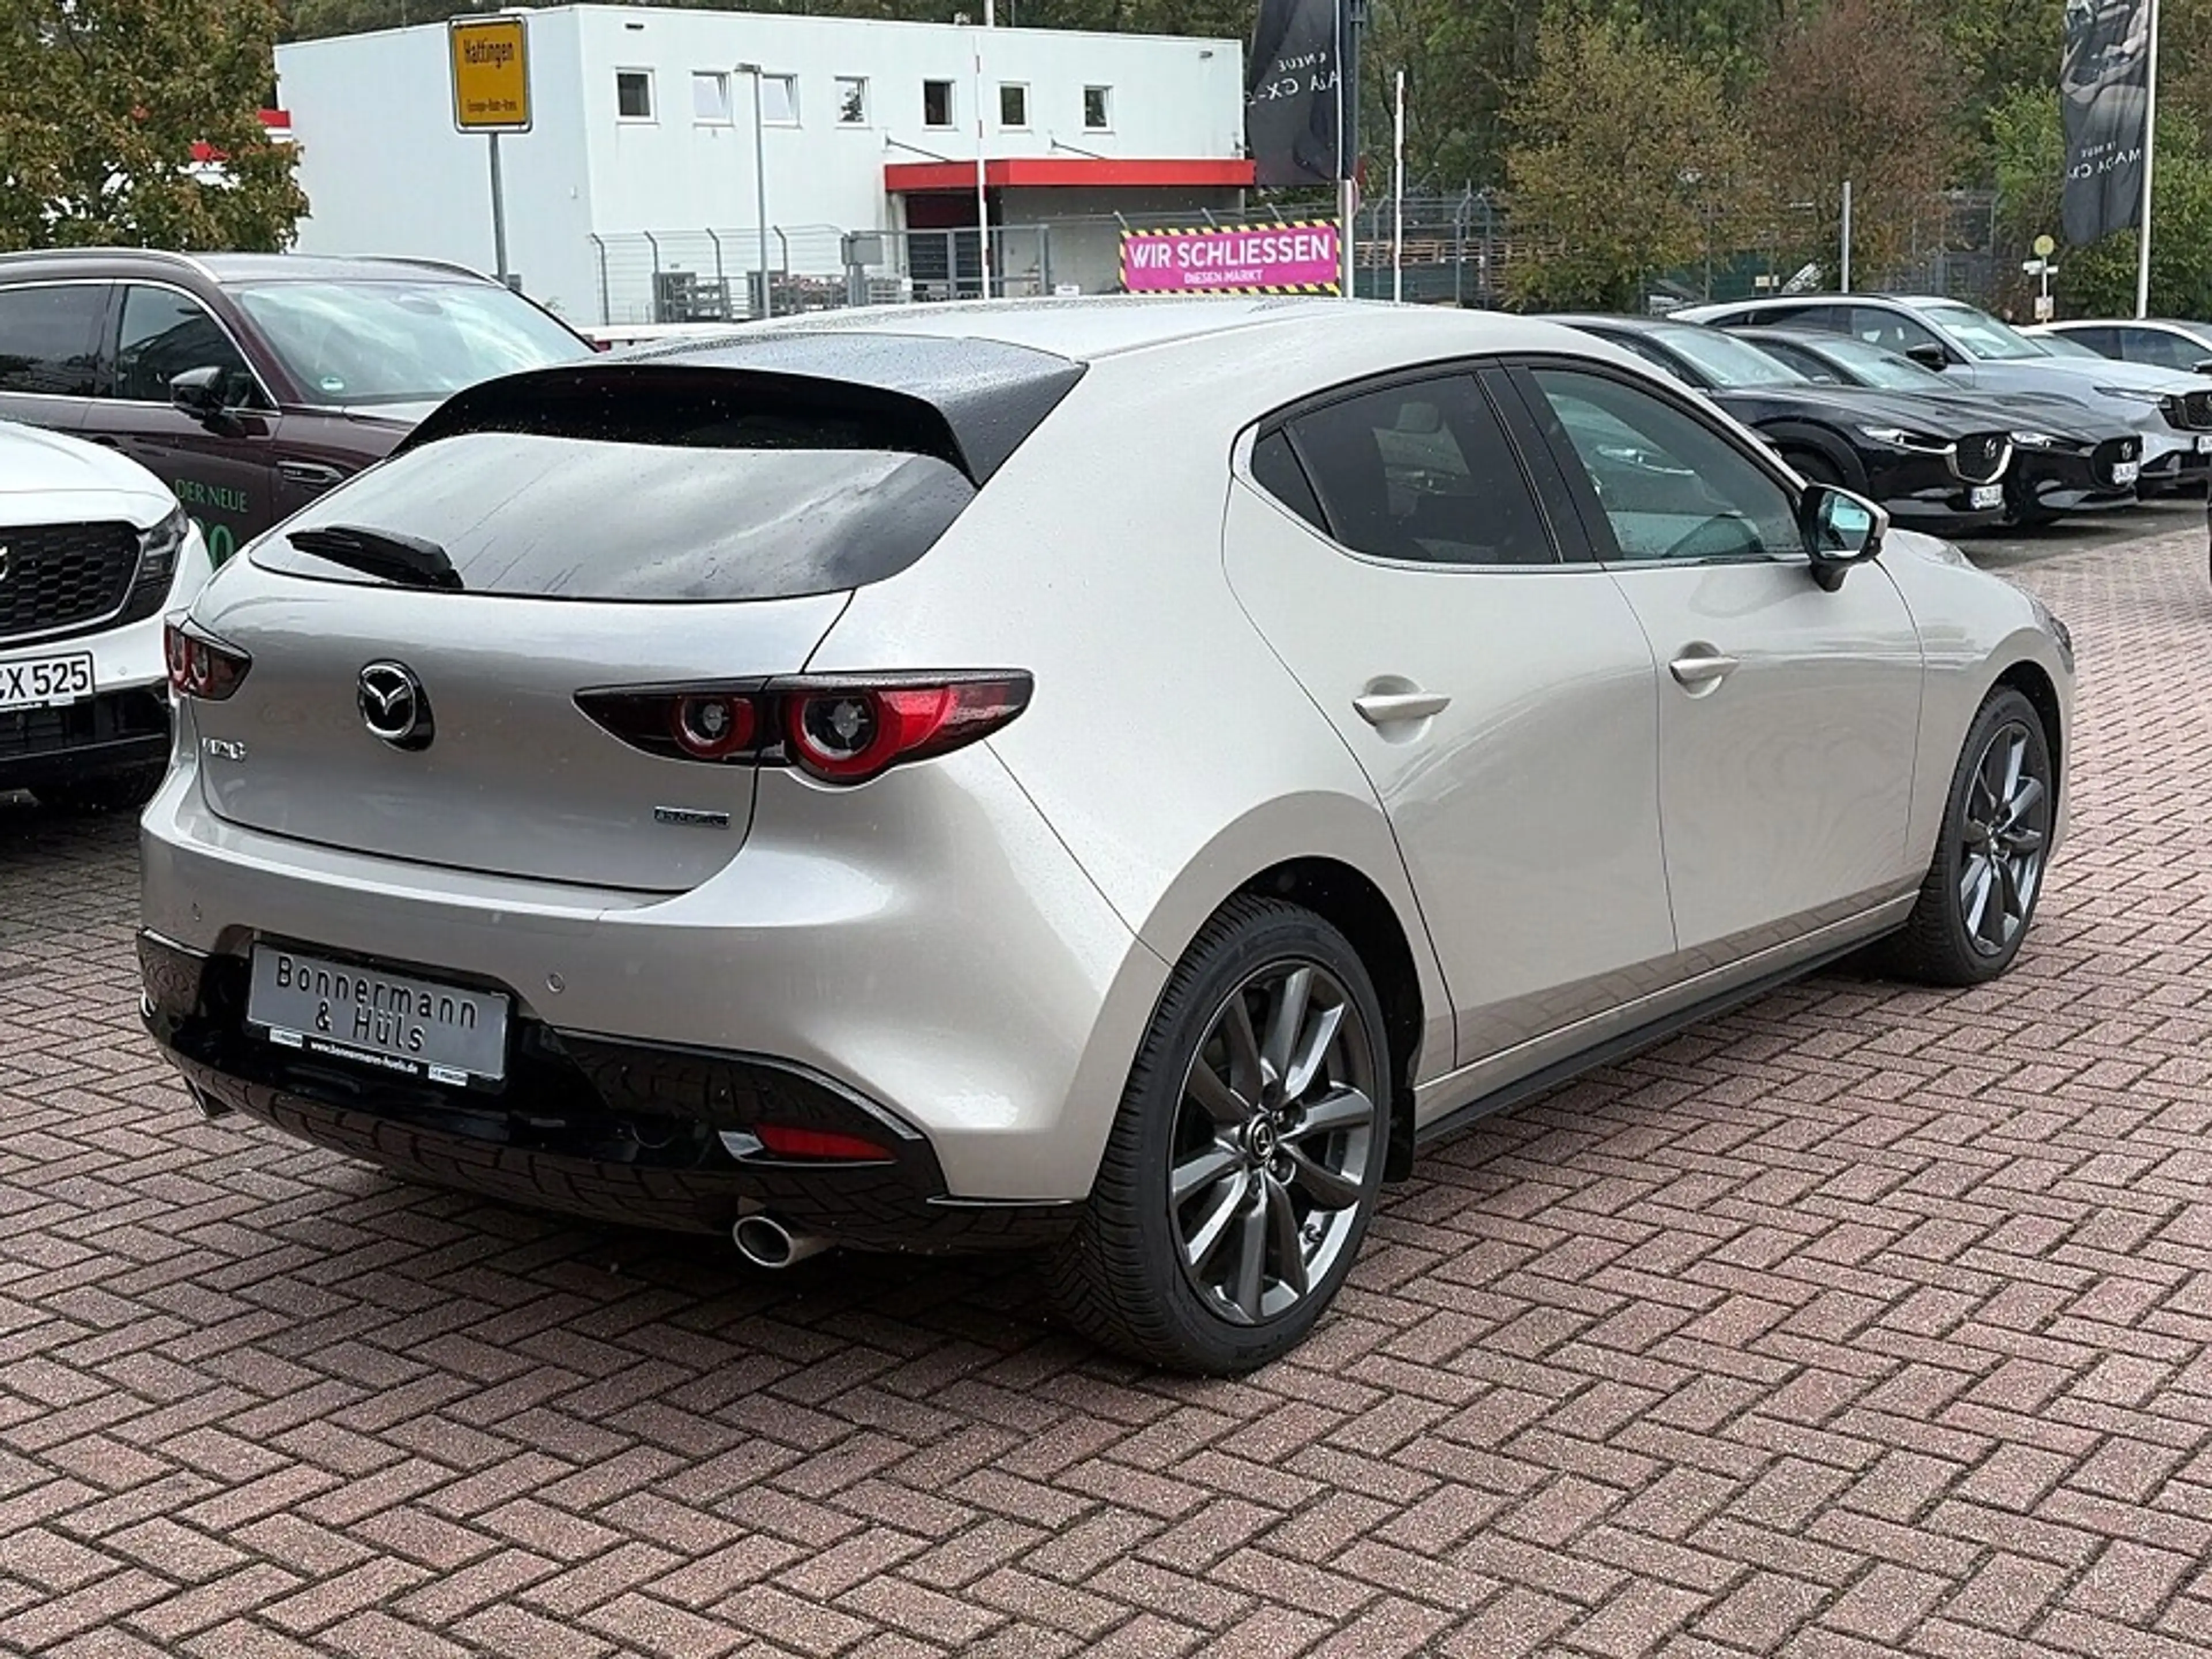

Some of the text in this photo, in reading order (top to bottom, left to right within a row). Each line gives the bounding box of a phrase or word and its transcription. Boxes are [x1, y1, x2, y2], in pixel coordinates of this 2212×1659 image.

[1129, 234, 1330, 269] WIR SCHLIESSEN
[1184, 269, 1263, 285] DIESEN MARKT
[175, 479, 249, 513] DER NEUE
[32, 659, 88, 696] 525
[276, 955, 478, 1029] Bonnermann
[315, 999, 426, 1052] & Hüls
